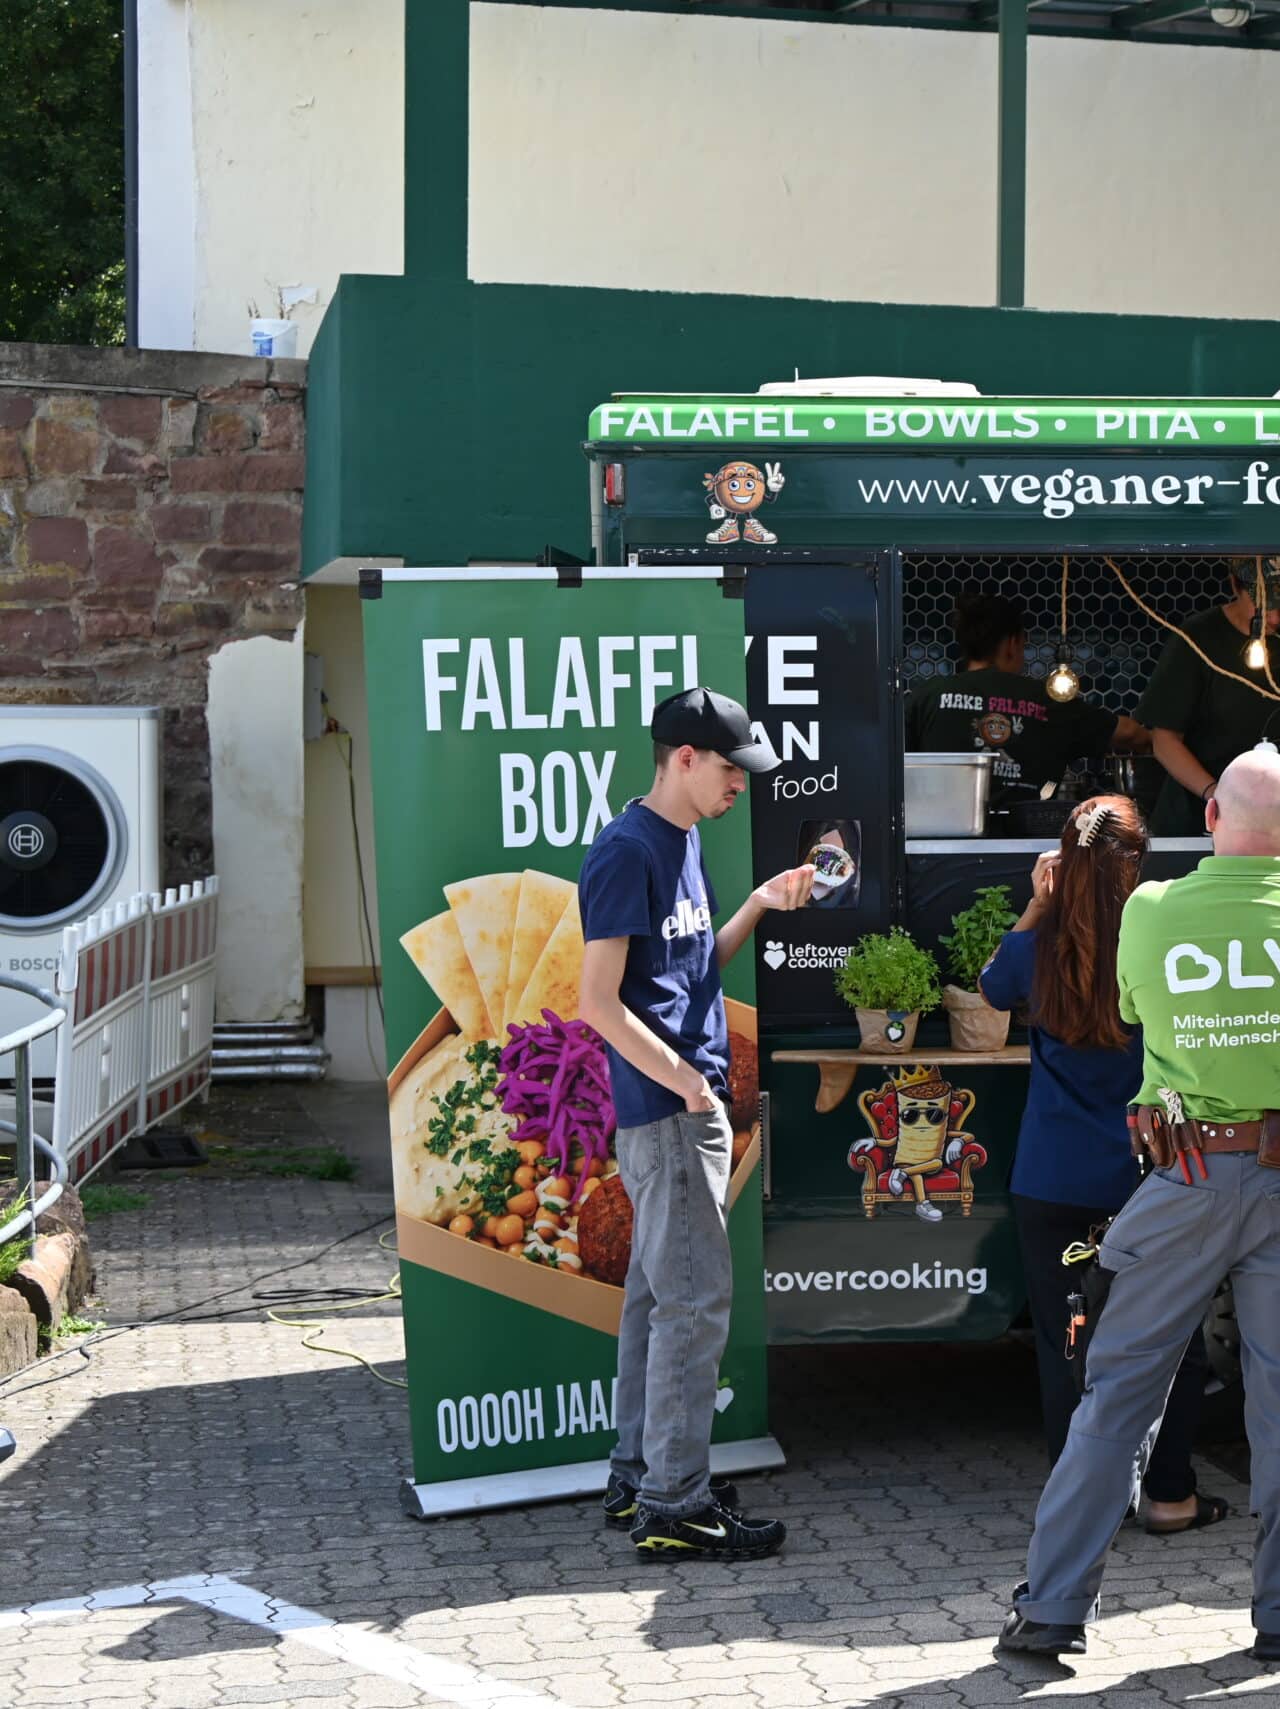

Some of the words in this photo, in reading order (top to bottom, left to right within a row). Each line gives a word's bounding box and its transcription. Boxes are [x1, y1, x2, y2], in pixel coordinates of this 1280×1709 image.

[599, 406, 810, 438] FALAFEL
[864, 406, 1041, 438] BOWLS
[1096, 406, 1200, 440] PITA
[939, 692, 983, 711] MAKE
[500, 750, 616, 848] BOX
[771, 765, 838, 801] food
[788, 943, 856, 958] leftover
[1174, 1033, 1205, 1049] Für
[436, 1386, 545, 1455] OOOOH
